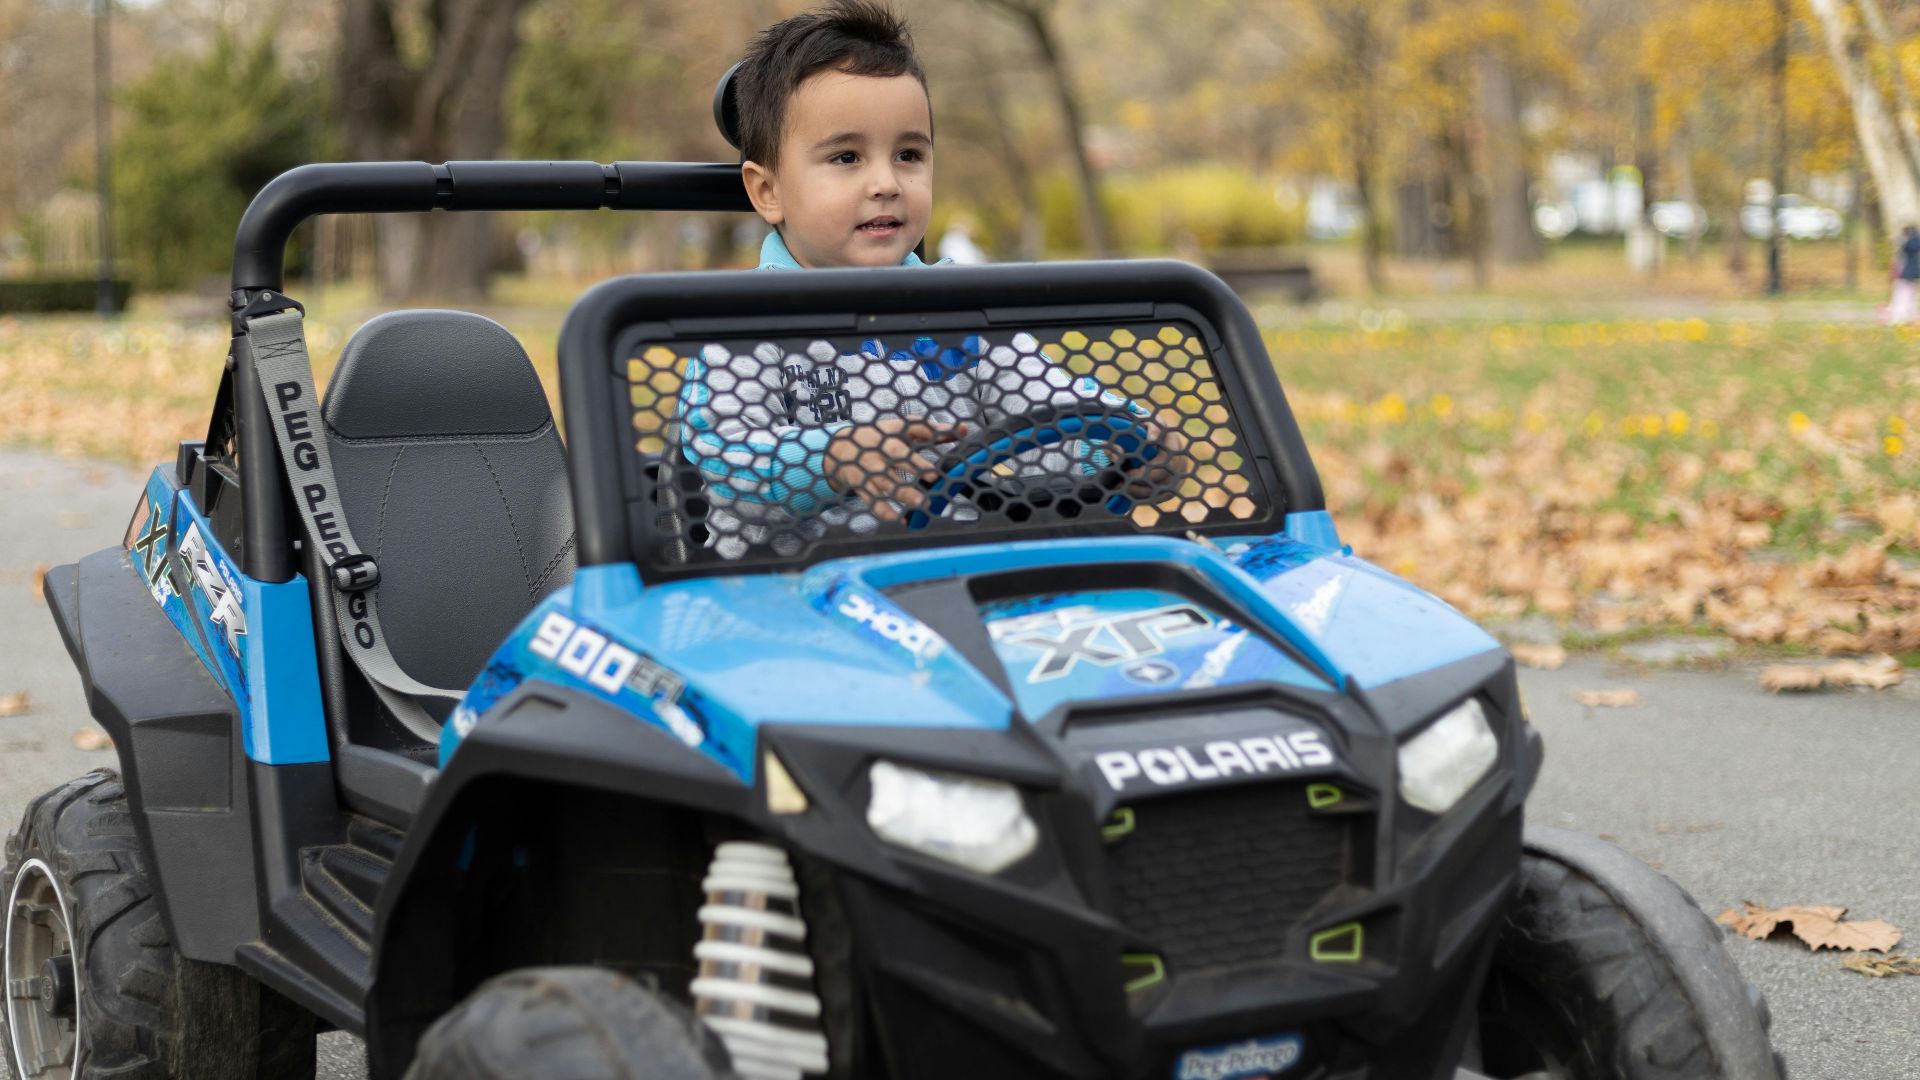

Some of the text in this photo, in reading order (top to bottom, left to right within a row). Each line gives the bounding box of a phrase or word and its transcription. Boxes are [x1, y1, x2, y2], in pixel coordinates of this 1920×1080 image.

[275, 380, 320, 472] PEG
[179, 520, 248, 659] RZR
[218, 558, 244, 604] POLARIS
[528, 610, 640, 695] 900
[1004, 603, 1217, 685] XP
[1094, 730, 1334, 791] POLARIS
